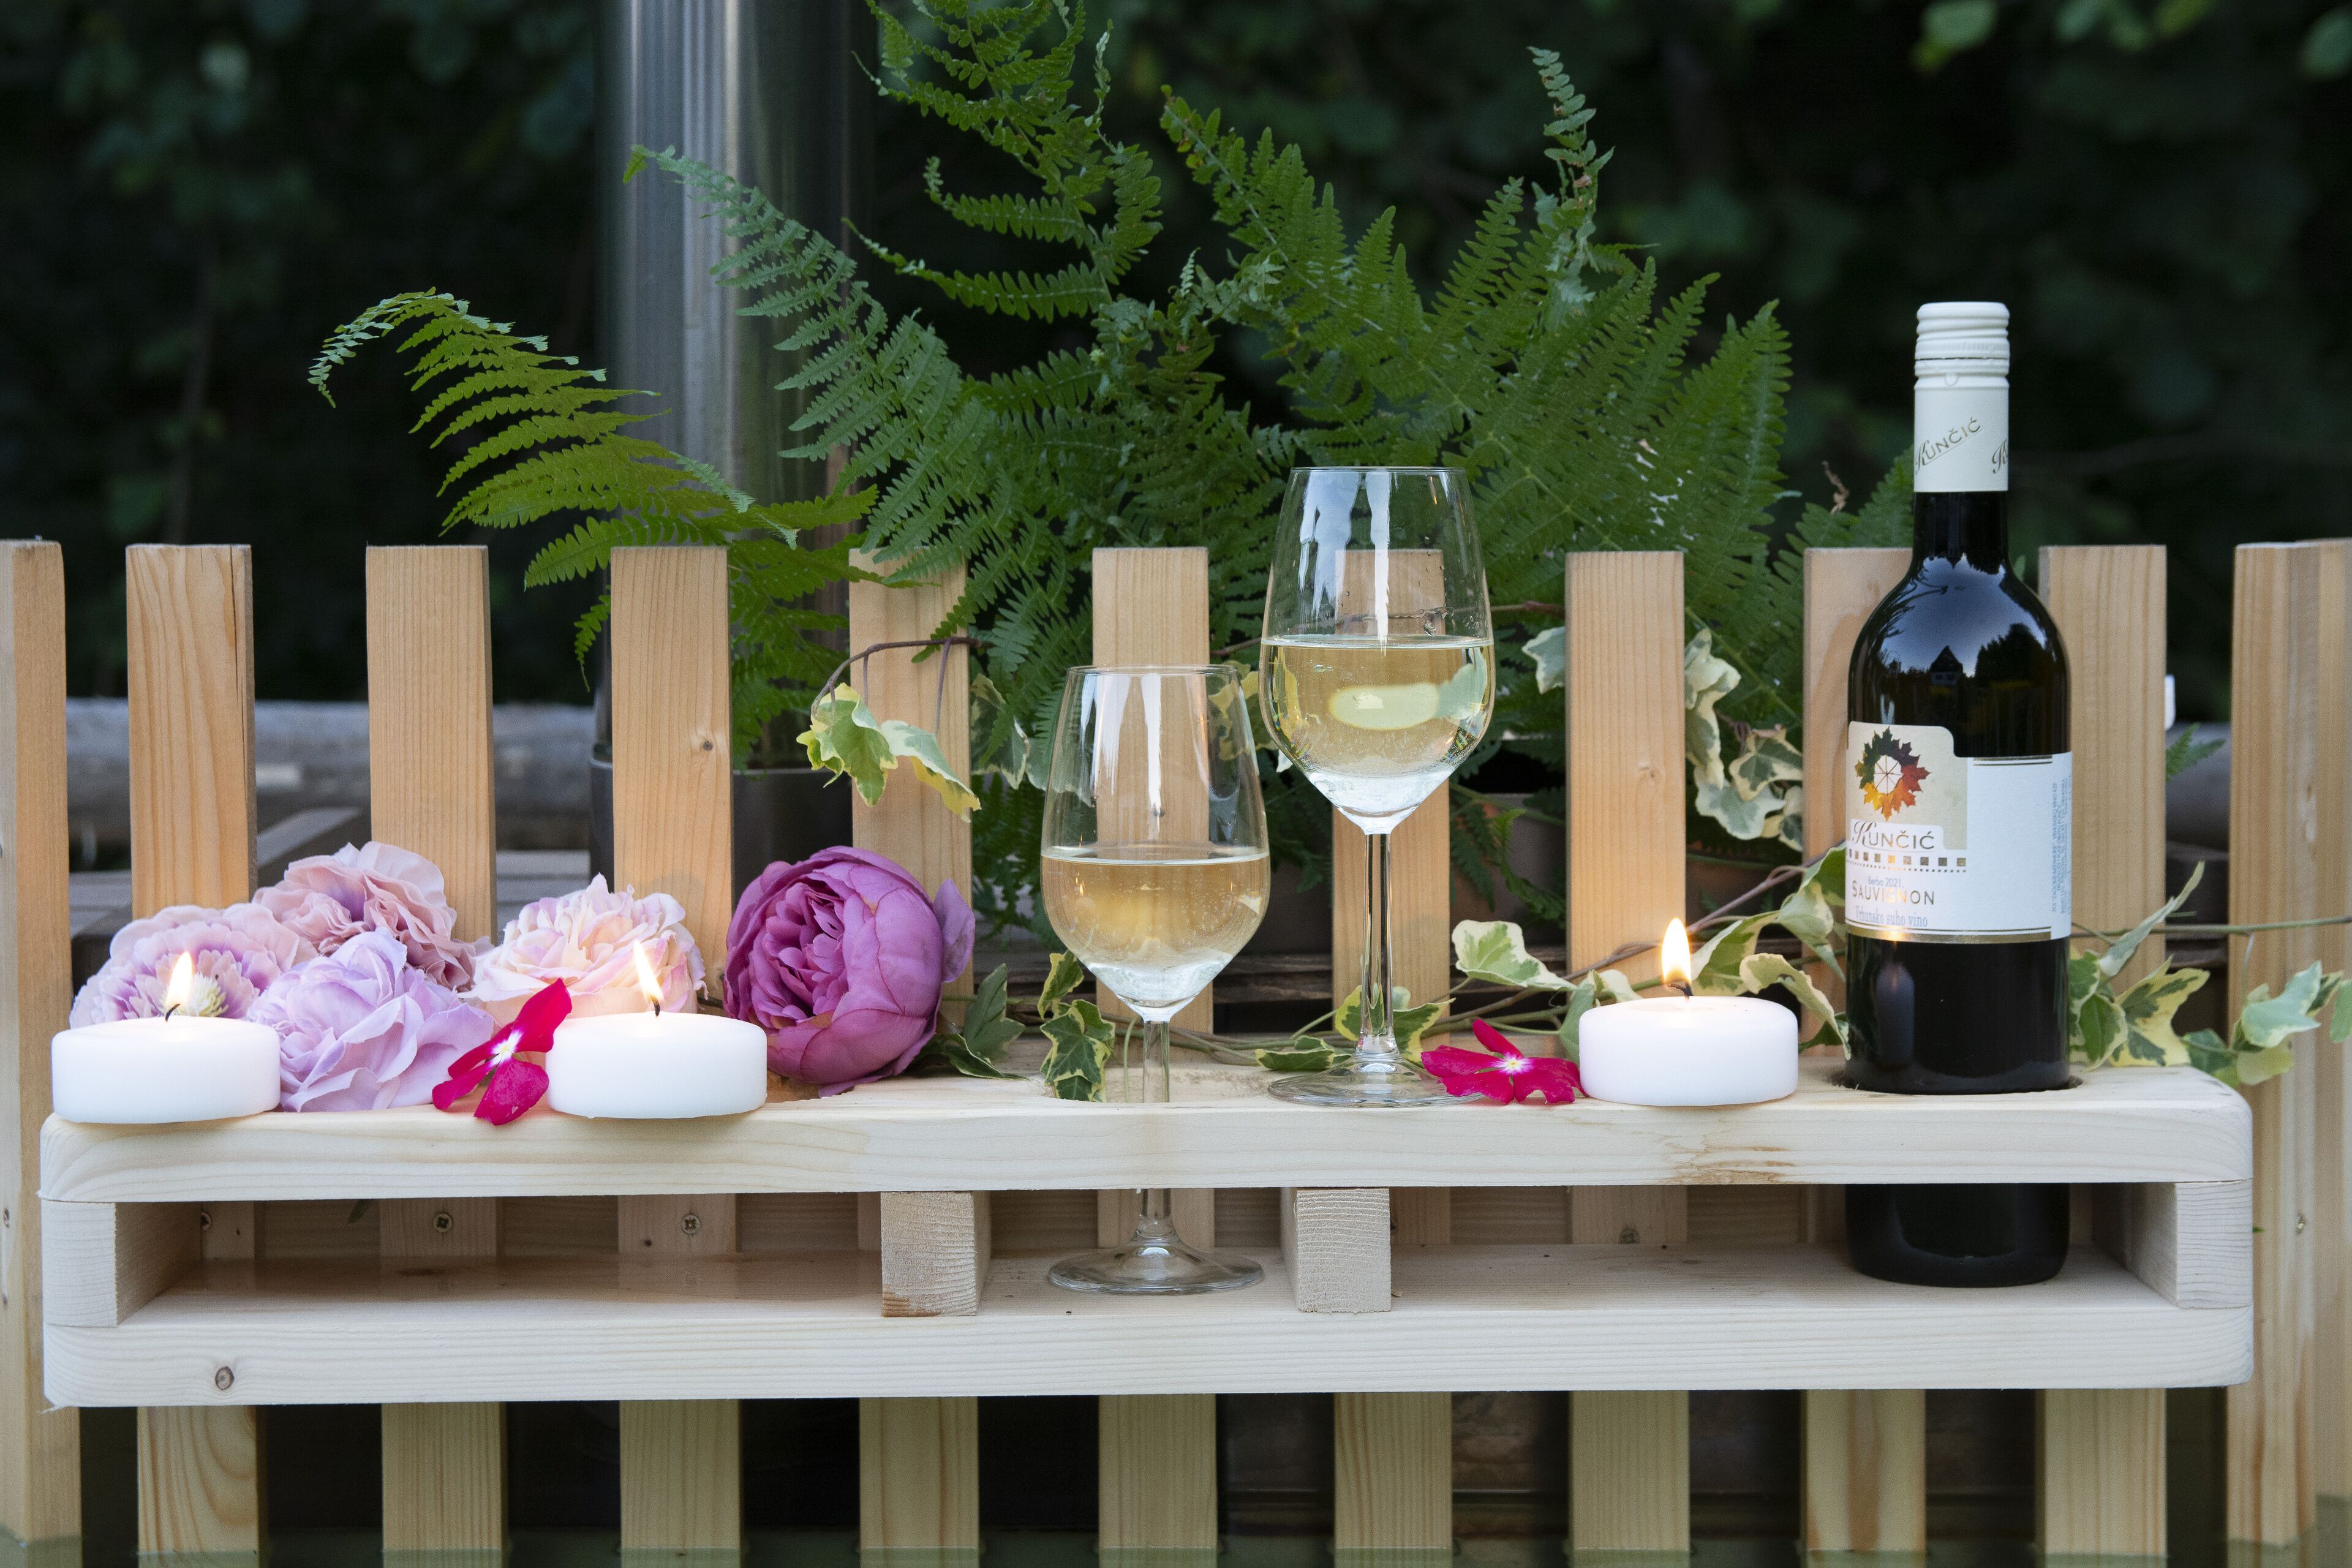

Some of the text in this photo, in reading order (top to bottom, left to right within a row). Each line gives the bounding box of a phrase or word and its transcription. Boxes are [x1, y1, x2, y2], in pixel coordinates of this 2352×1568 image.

[1915, 417, 1981, 475] KUNČIĆ
[1852, 821, 1936, 850] KUNČIĆ
[1852, 880, 1934, 905] SAUVIGNON
[1855, 905, 1928, 927] Vrhunsko suho vino
